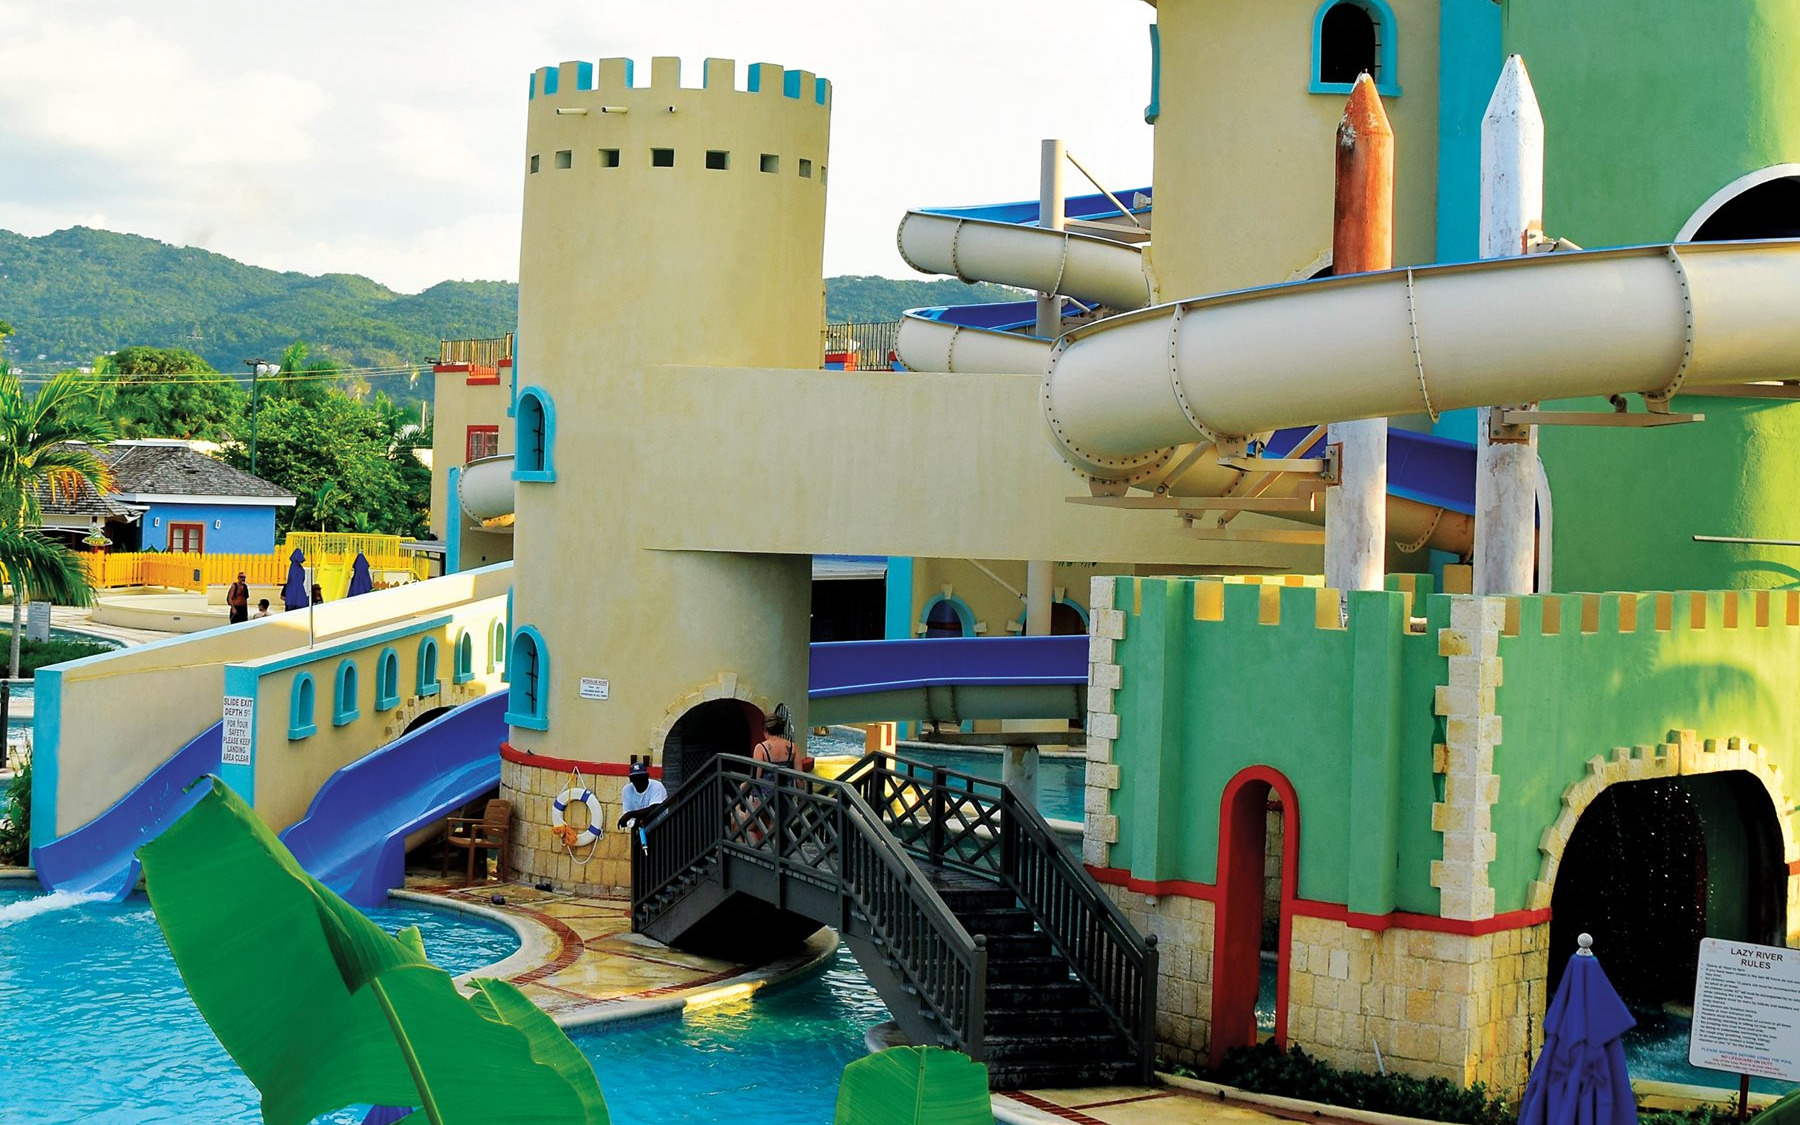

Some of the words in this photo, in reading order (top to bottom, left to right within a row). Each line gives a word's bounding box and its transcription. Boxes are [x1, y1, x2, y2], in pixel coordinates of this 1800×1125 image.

[224, 698, 239, 706] SLIDE
[240, 699, 253, 707] EXIT
[225, 708, 242, 716] DEPTH
[237, 720, 248, 728] YOUR
[223, 737, 238, 745] PLEASE
[226, 745, 246, 753] LANDING
[223, 753, 234, 761] AREA
[1730, 948, 1754, 957] LAZY
[1755, 951, 1783, 962] RIVER
[1740, 958, 1771, 969] RULES
